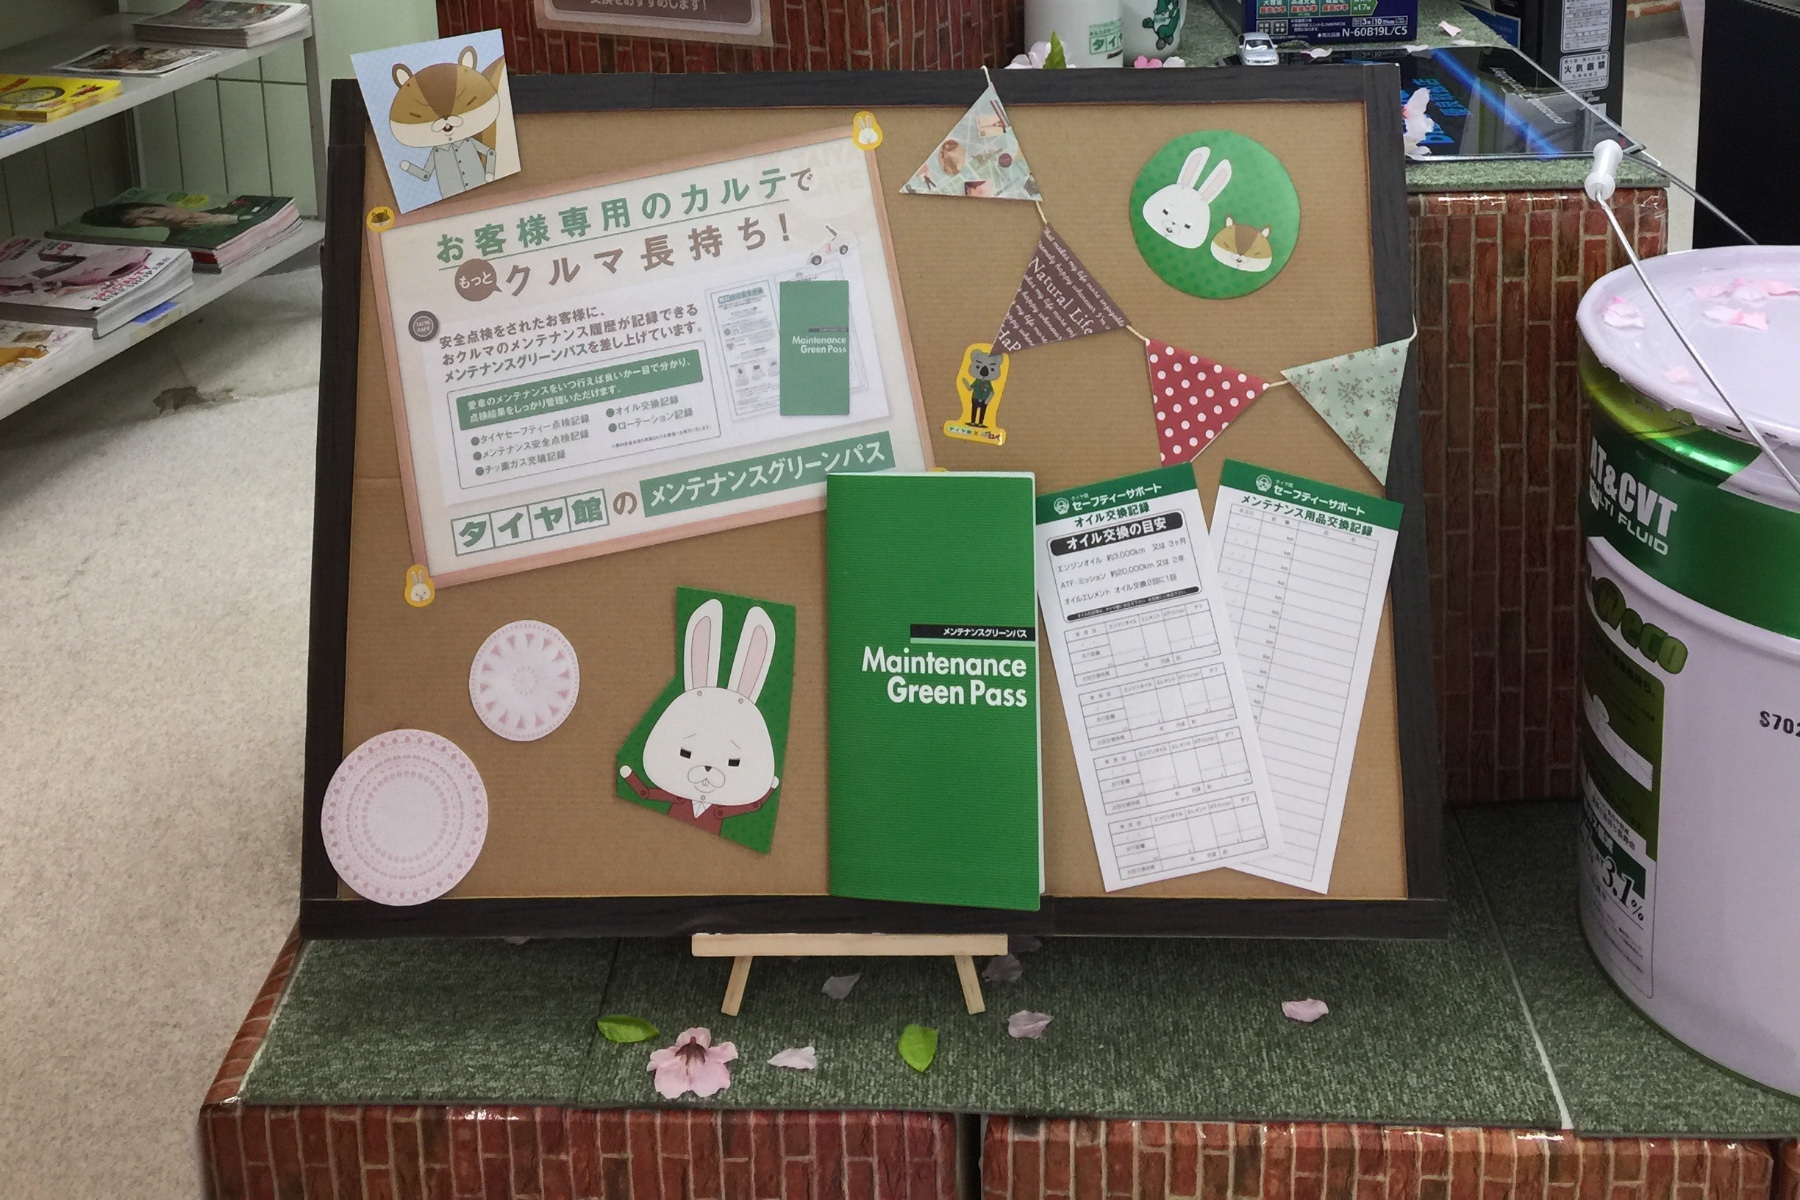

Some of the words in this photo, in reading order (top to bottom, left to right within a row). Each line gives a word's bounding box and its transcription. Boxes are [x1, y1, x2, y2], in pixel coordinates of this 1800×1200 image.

[1341, 25, 1409, 39] N-60B19L/C5
[436, 166, 814, 265] お客様専用のカルテで
[505, 212, 791, 297] クルマ長持ち!
[458, 270, 494, 290] もっと
[1028, 255, 1074, 310] Natural
[1069, 307, 1094, 335] Life
[438, 306, 606, 350] 安全点検をされたお客様に、
[442, 302, 699, 367] おクルマのメンテナンス履歴が記録できる
[791, 335, 848, 345] Maintenance
[444, 320, 703, 384] メンテナンスグリーンパスを差し上げています。
[800, 344, 827, 354] Green
[827, 344, 847, 354] Pass
[614, 394, 680, 417] オイル交換記録
[618, 406, 694, 432] ローテーション記録
[480, 413, 590, 445] タイヤセーフティー点検記録
[482, 429, 590, 460] メンテナンス安全点検記録
[650, 440, 887, 508] メンテナンスグリーンパス
[1071, 483, 1163, 512] セーフティーサポート
[1273, 483, 1366, 516] セーフティーサポート
[1074, 501, 1151, 528] オイル交換記録
[1241, 494, 1374, 537] メンテナンス用品交換記録
[1066, 516, 1168, 551] オイル交換の目安
[1617, 511, 1670, 556] FLUID
[1057, 555, 1103, 573] エンジンオイル
[1151, 541, 1166, 552] 又は
[1156, 558, 1170, 569] 又は
[1064, 588, 1112, 607] オイルエレメント
[942, 627, 1028, 639] メンテナンスグリーンパス
[861, 645, 1027, 677] Maintenance
[886, 675, 965, 705] Green
[969, 679, 1028, 708] Pass
